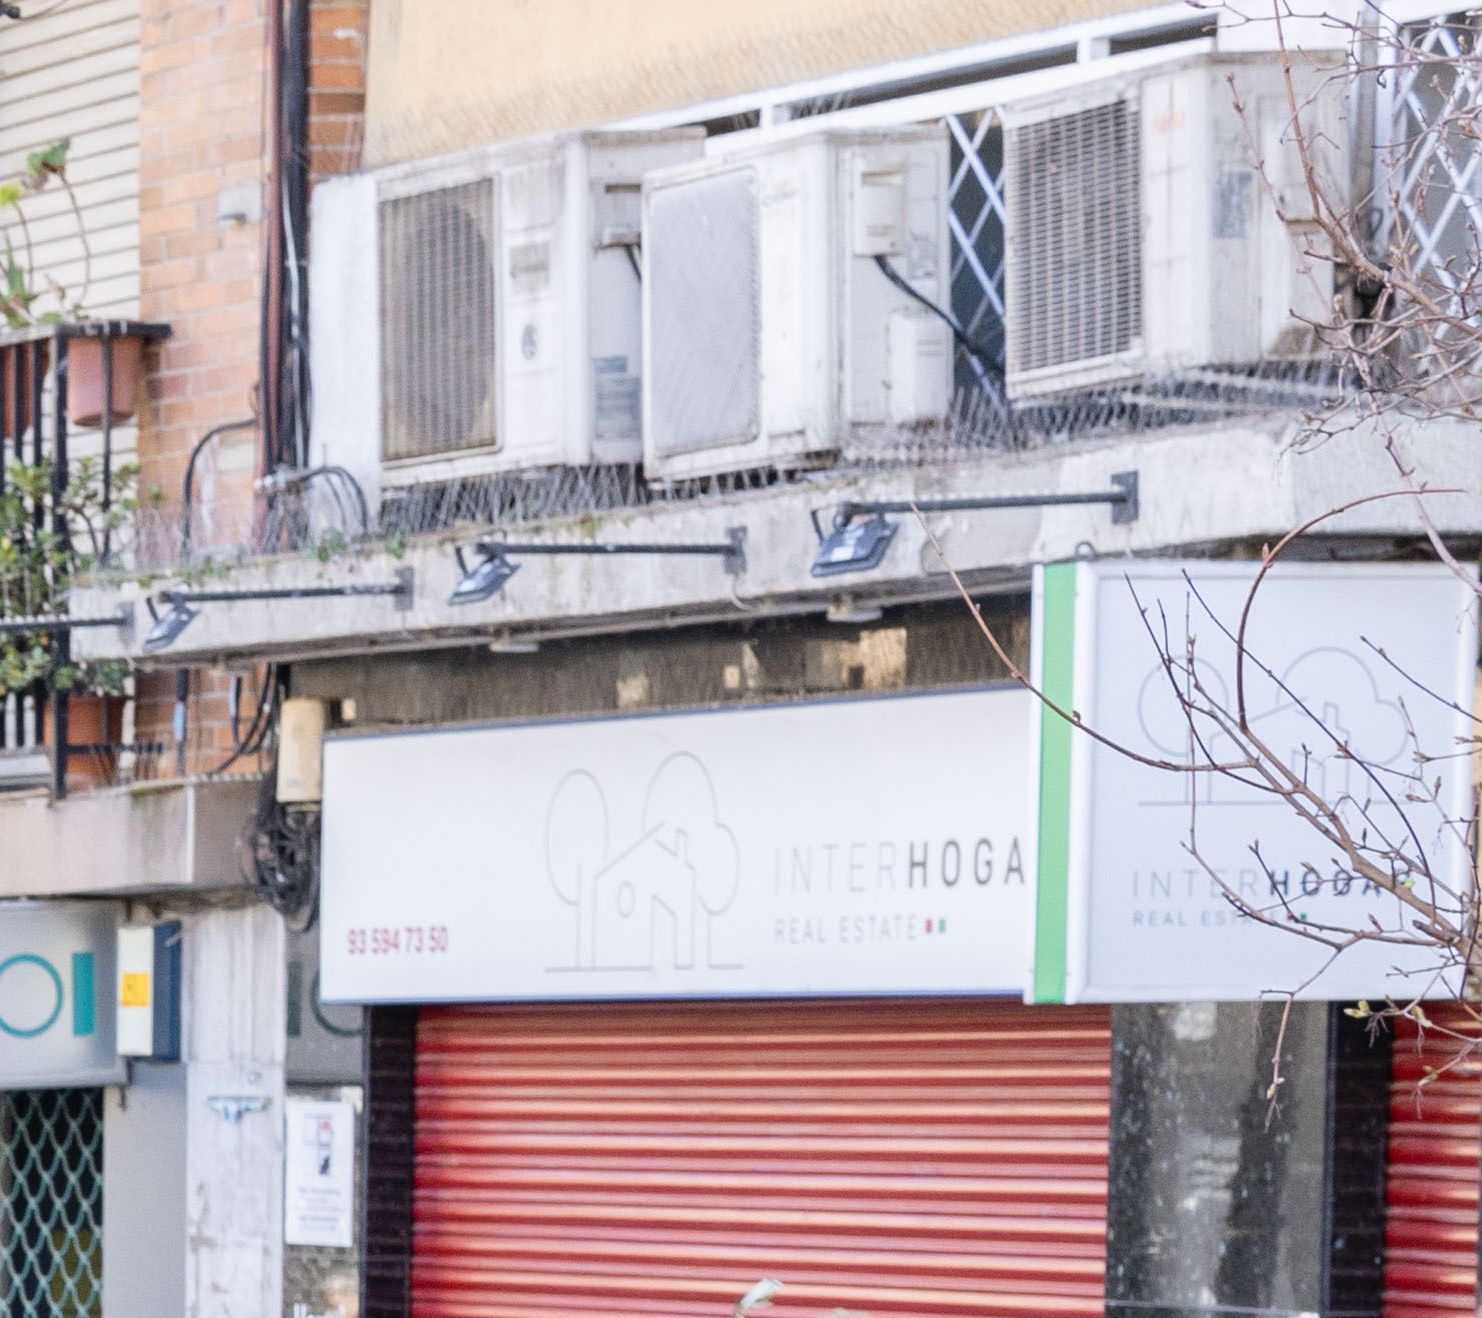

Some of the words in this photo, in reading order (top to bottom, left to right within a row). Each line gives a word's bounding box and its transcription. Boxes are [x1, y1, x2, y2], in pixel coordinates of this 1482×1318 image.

[774, 836, 1026, 894] INTERHOGA
[774, 916, 828, 945] REAL
[840, 913, 919, 943] ESTATE
[1132, 909, 1188, 928] REAL
[348, 927, 366, 954] 93
[371, 926, 399, 954] 594
[405, 925, 423, 952] 73
[429, 924, 449, 952] 50
